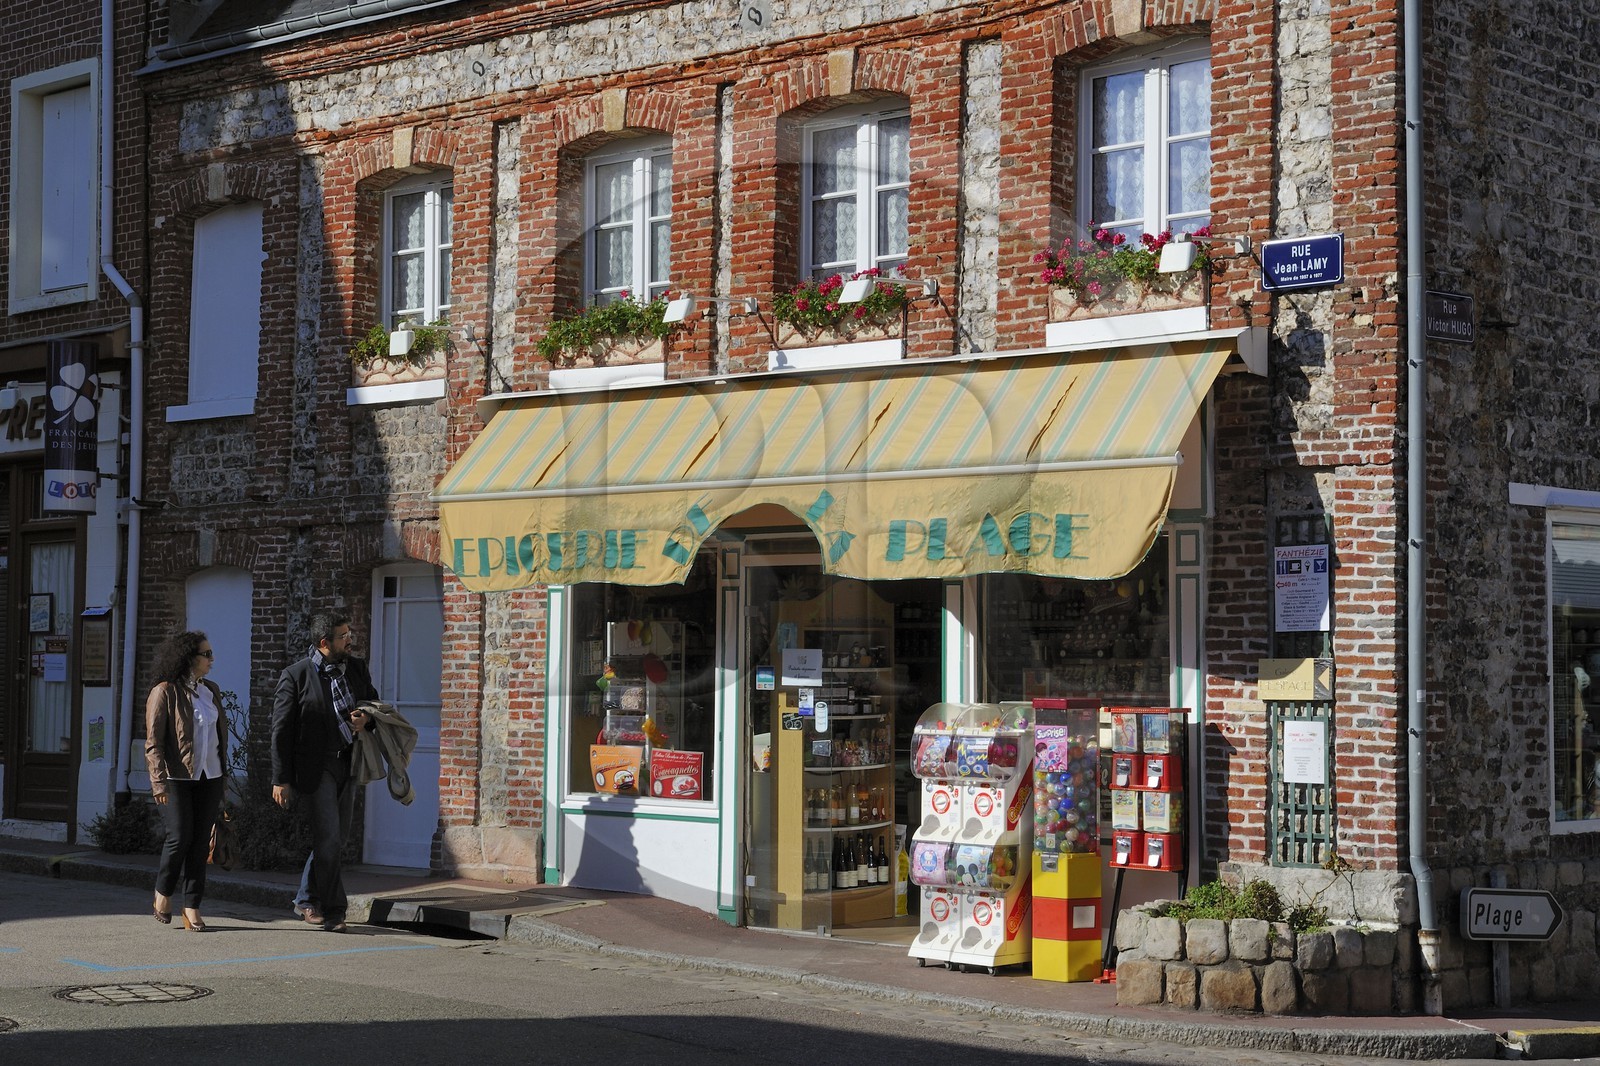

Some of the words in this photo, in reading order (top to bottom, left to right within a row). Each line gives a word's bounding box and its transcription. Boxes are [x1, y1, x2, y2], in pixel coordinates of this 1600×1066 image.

[1291, 244, 1311, 258] RUE
[1274, 262, 1298, 275] Jean
[1300, 256, 1328, 272] LAMY
[1443, 299, 1458, 315] Rue
[1427, 317, 1450, 333] Victor
[1451, 318, 1473, 336] HUGO
[52, 441, 73, 449] DES
[48, 480, 97, 499] LOTO
[453, 528, 650, 578] EPICERIE
[885, 511, 1089, 562] PLAGE
[1276, 547, 1325, 558] FANTHÉZIE
[1474, 903, 1523, 932] Plage
